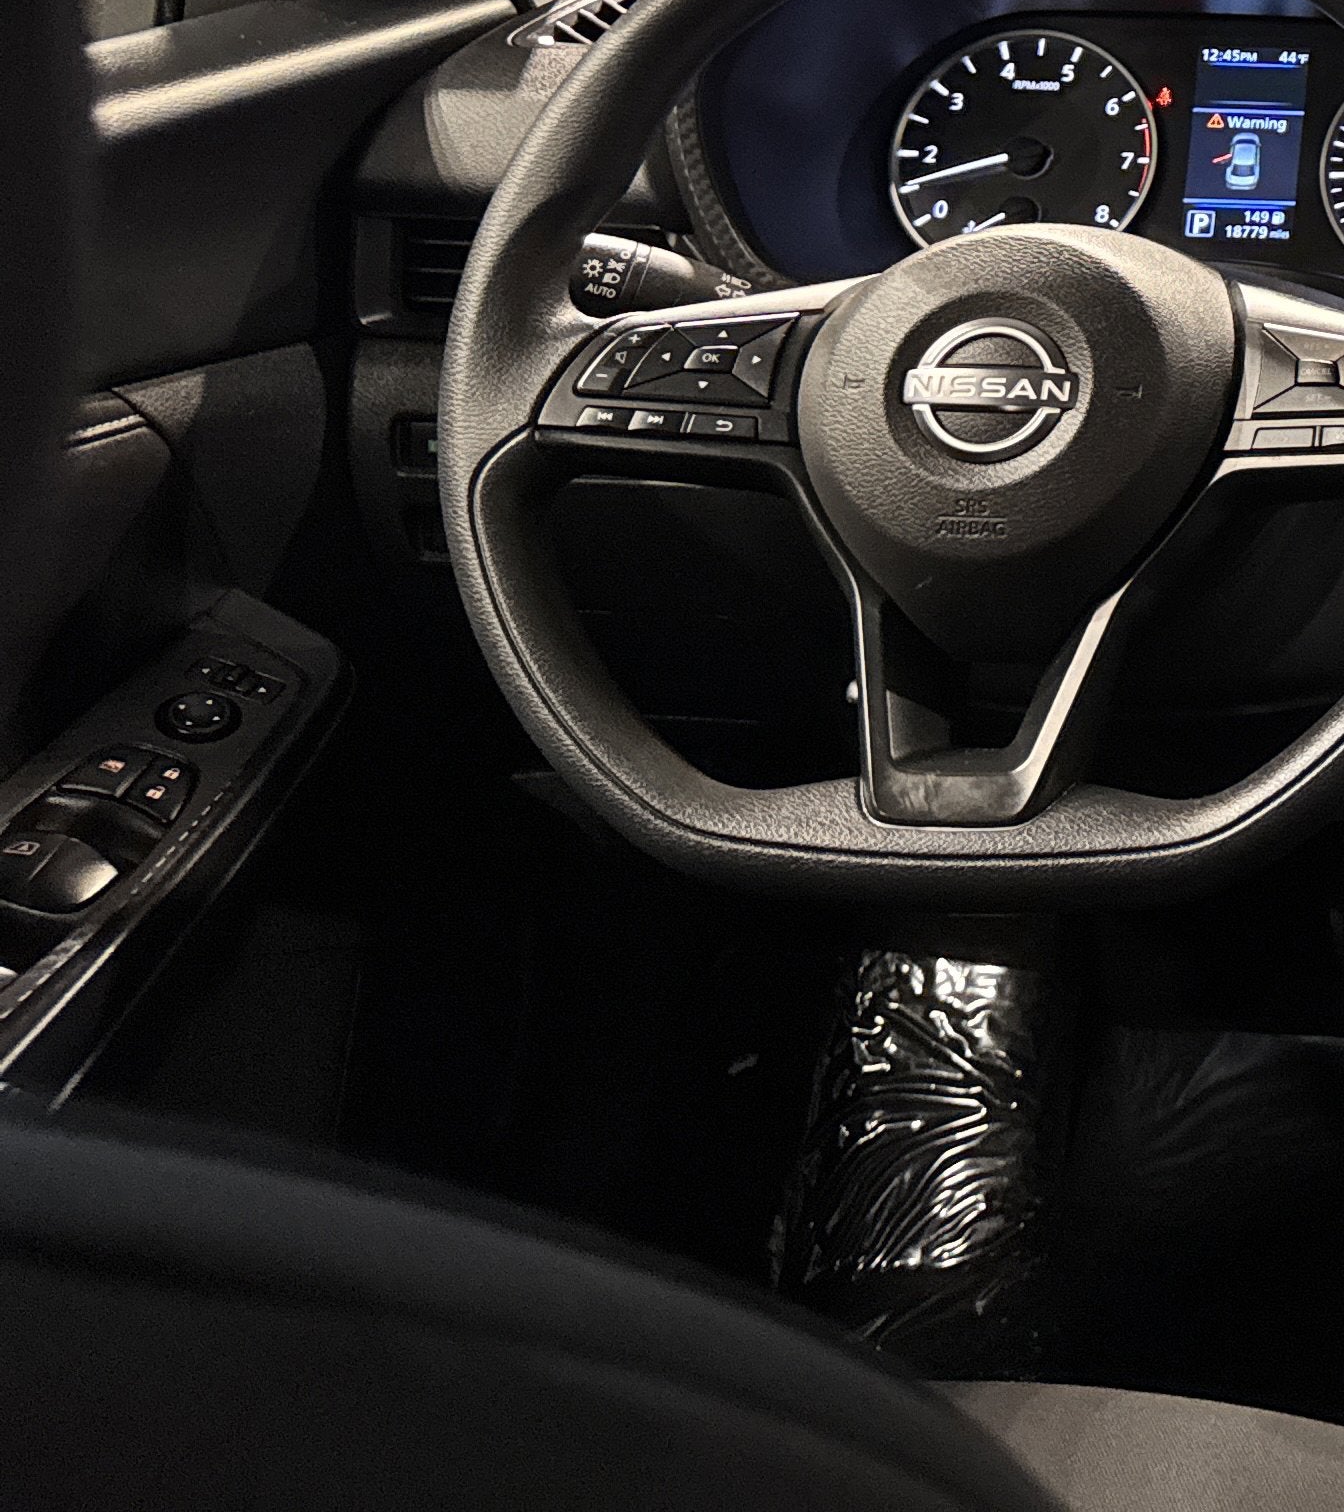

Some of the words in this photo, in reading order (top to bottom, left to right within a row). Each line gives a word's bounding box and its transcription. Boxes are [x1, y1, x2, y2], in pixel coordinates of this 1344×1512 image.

[999, 62, 1016, 80] 4
[1060, 63, 1075, 83] 5
[949, 92, 964, 111] 3
[1104, 97, 1120, 116] 6
[1226, 115, 1288, 134] Warning
[921, 144, 938, 164] 2
[1120, 151, 1134, 170] 7
[1094, 204, 1110, 223] 8
[1243, 210, 1270, 224] 149
[1192, 213, 1211, 235] P
[1224, 224, 1268, 240] 18779
[584, 281, 617, 299] AUTO
[701, 352, 721, 365] OK
[907, 373, 1071, 402] NISSAN
[954, 497, 989, 516] SRS
[935, 519, 1007, 537] AIRBAG
